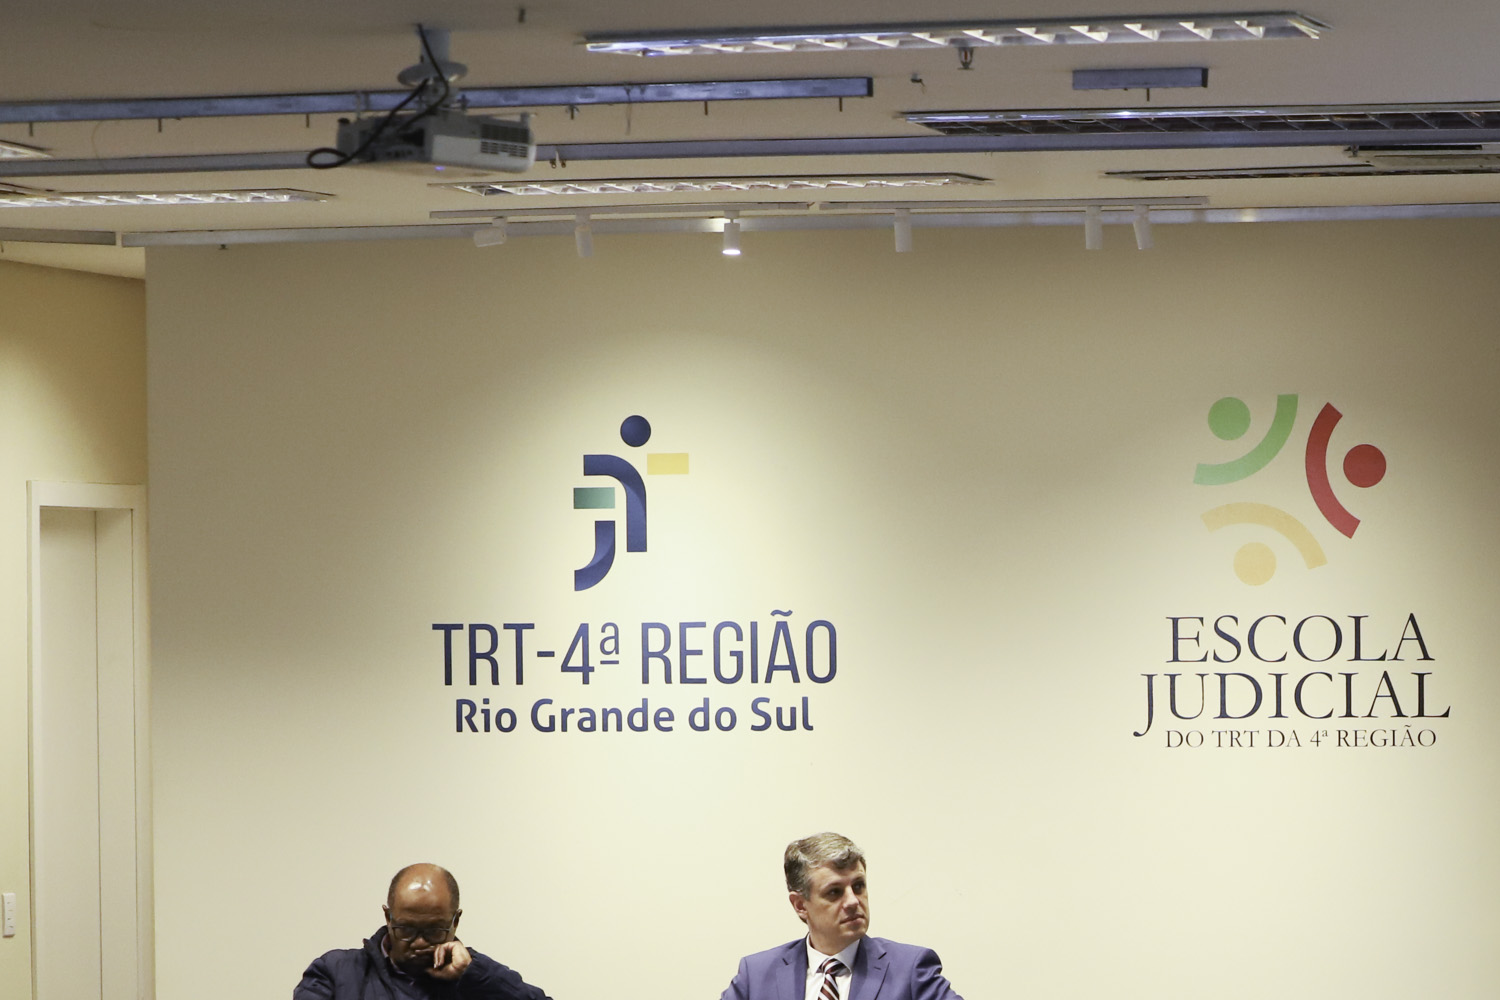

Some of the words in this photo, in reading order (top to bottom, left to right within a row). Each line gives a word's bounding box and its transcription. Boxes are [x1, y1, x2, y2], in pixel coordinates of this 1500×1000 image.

[432, 621, 620, 686] TRT-4ª
[641, 609, 837, 684] REGIÃO
[1165, 612, 1436, 663] ESCOLA
[456, 698, 517, 733] Rio
[531, 697, 675, 733] Grande
[688, 697, 737, 732] do
[750, 696, 814, 731] Sul
[1133, 670, 1450, 737] JUDICIAL
[1165, 729, 1204, 748] DO
[1211, 729, 1260, 748] TRT
[1267, 729, 1302, 748] DA
[1309, 729, 1329, 748] 4ª
[1336, 724, 1437, 748] REGIÃO
